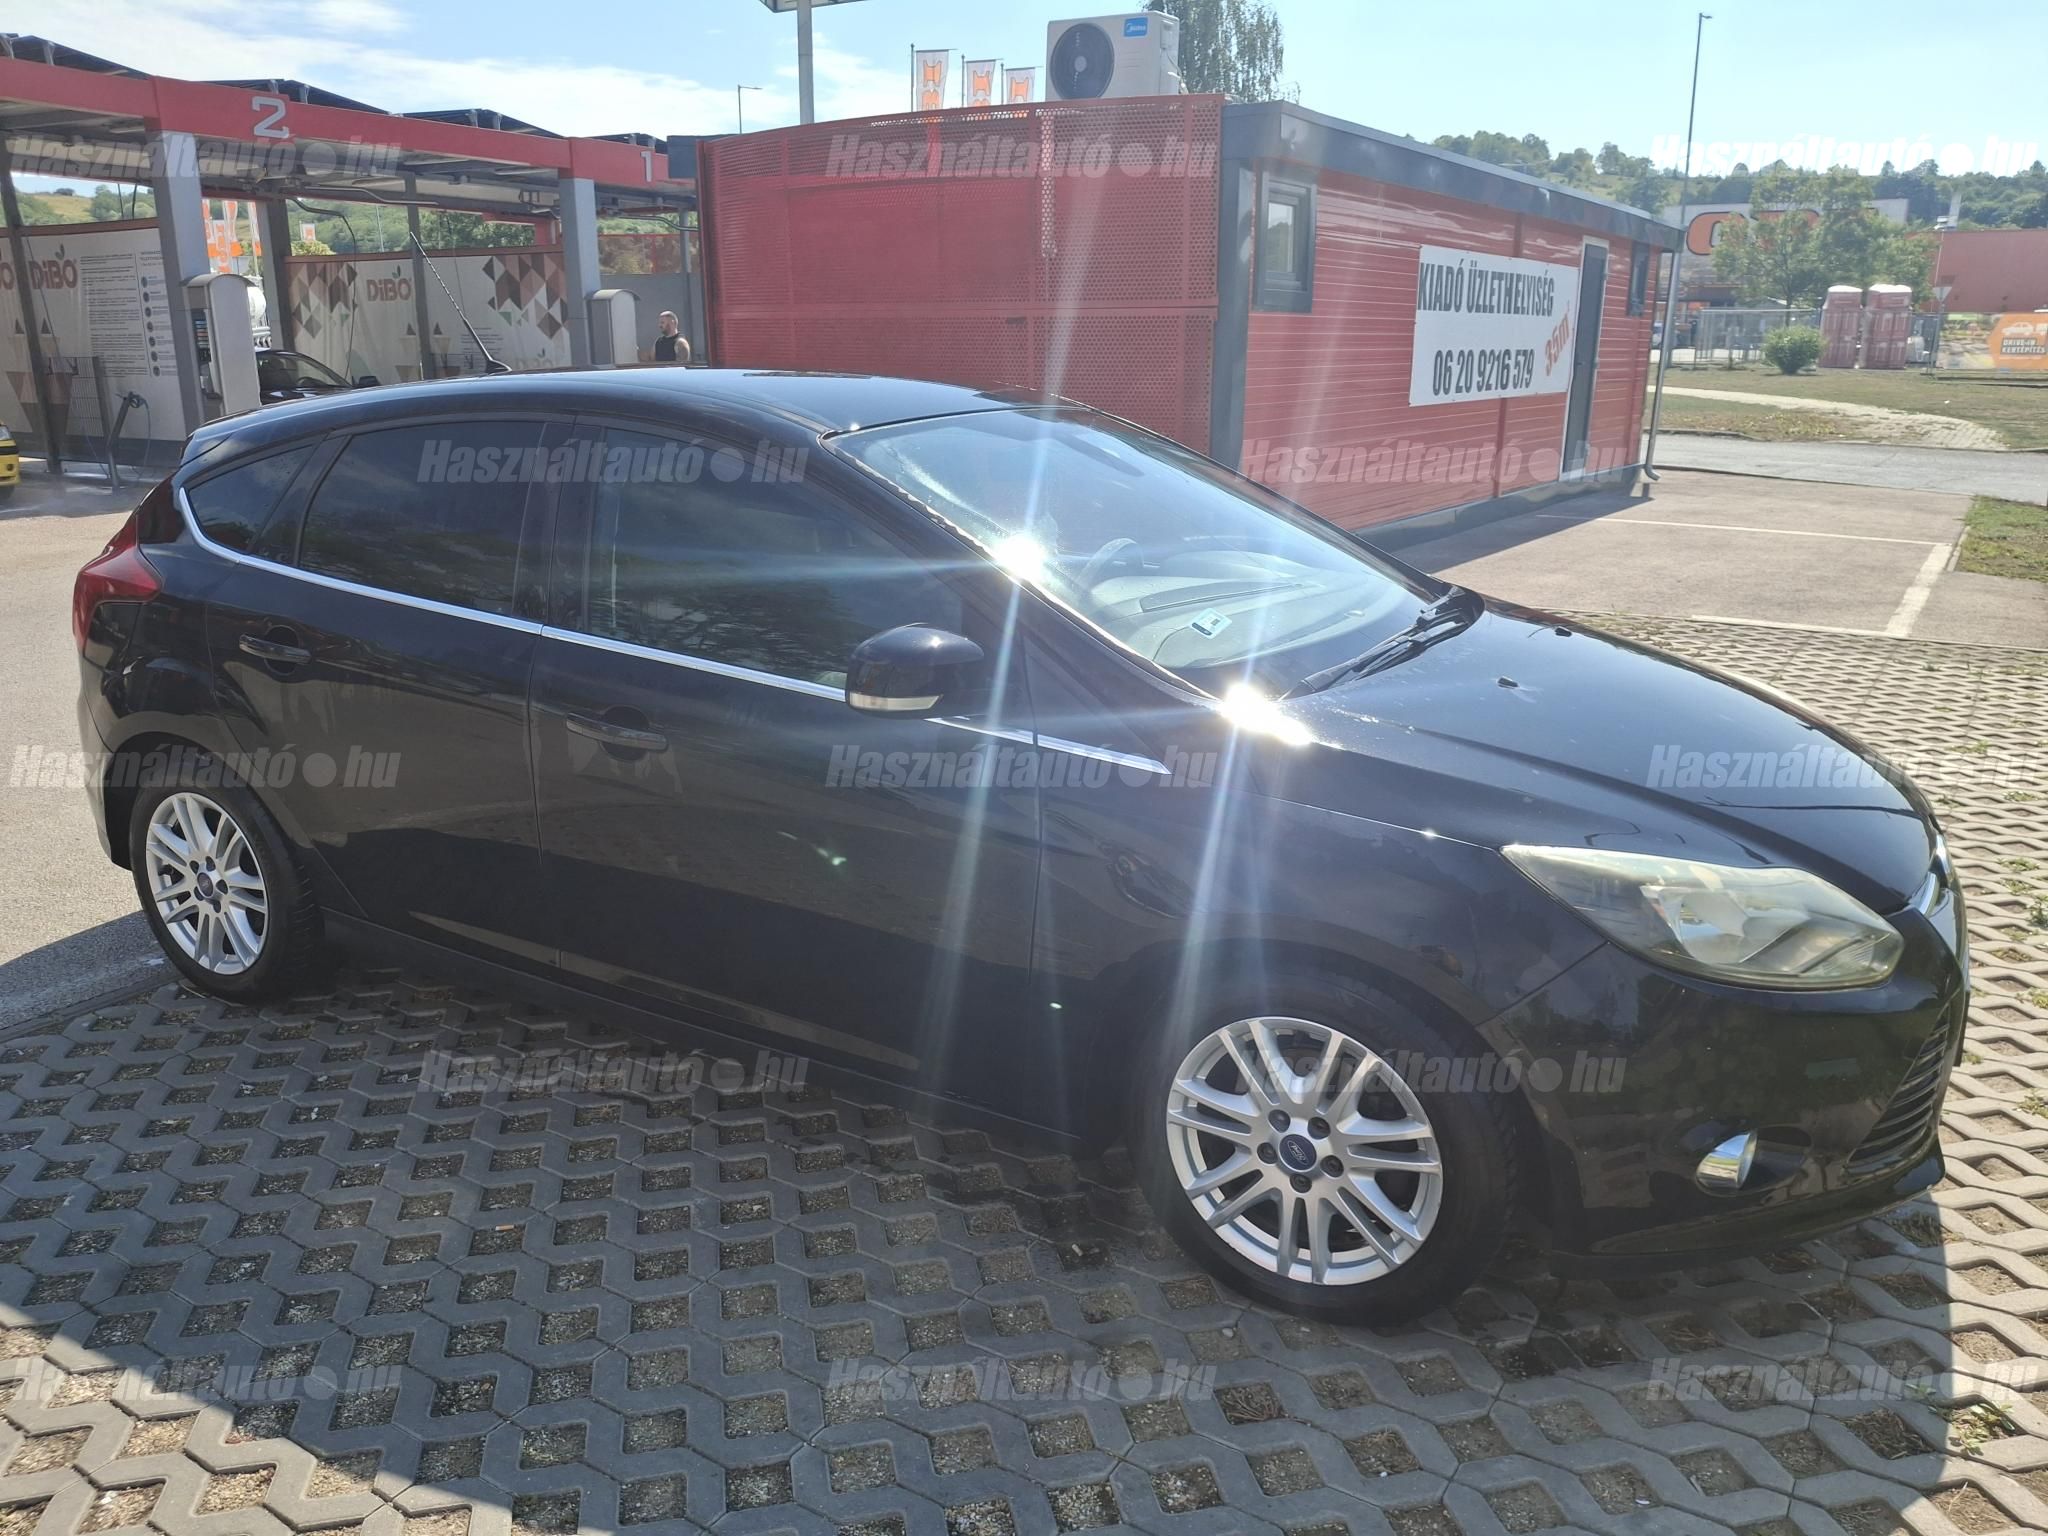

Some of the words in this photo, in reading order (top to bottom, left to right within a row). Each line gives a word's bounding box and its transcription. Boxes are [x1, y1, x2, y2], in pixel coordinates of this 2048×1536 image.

[252, 96, 289, 138] 2
[640, 150, 652, 182] 1
[1417, 258, 1465, 313] KIADÓ
[1467, 260, 1555, 317] ÜZLETHELYISÉG
[1432, 350, 1454, 396] 06
[1455, 349, 1474, 393] 20
[1477, 349, 1511, 392] 9216
[1513, 349, 1536, 389] 579
